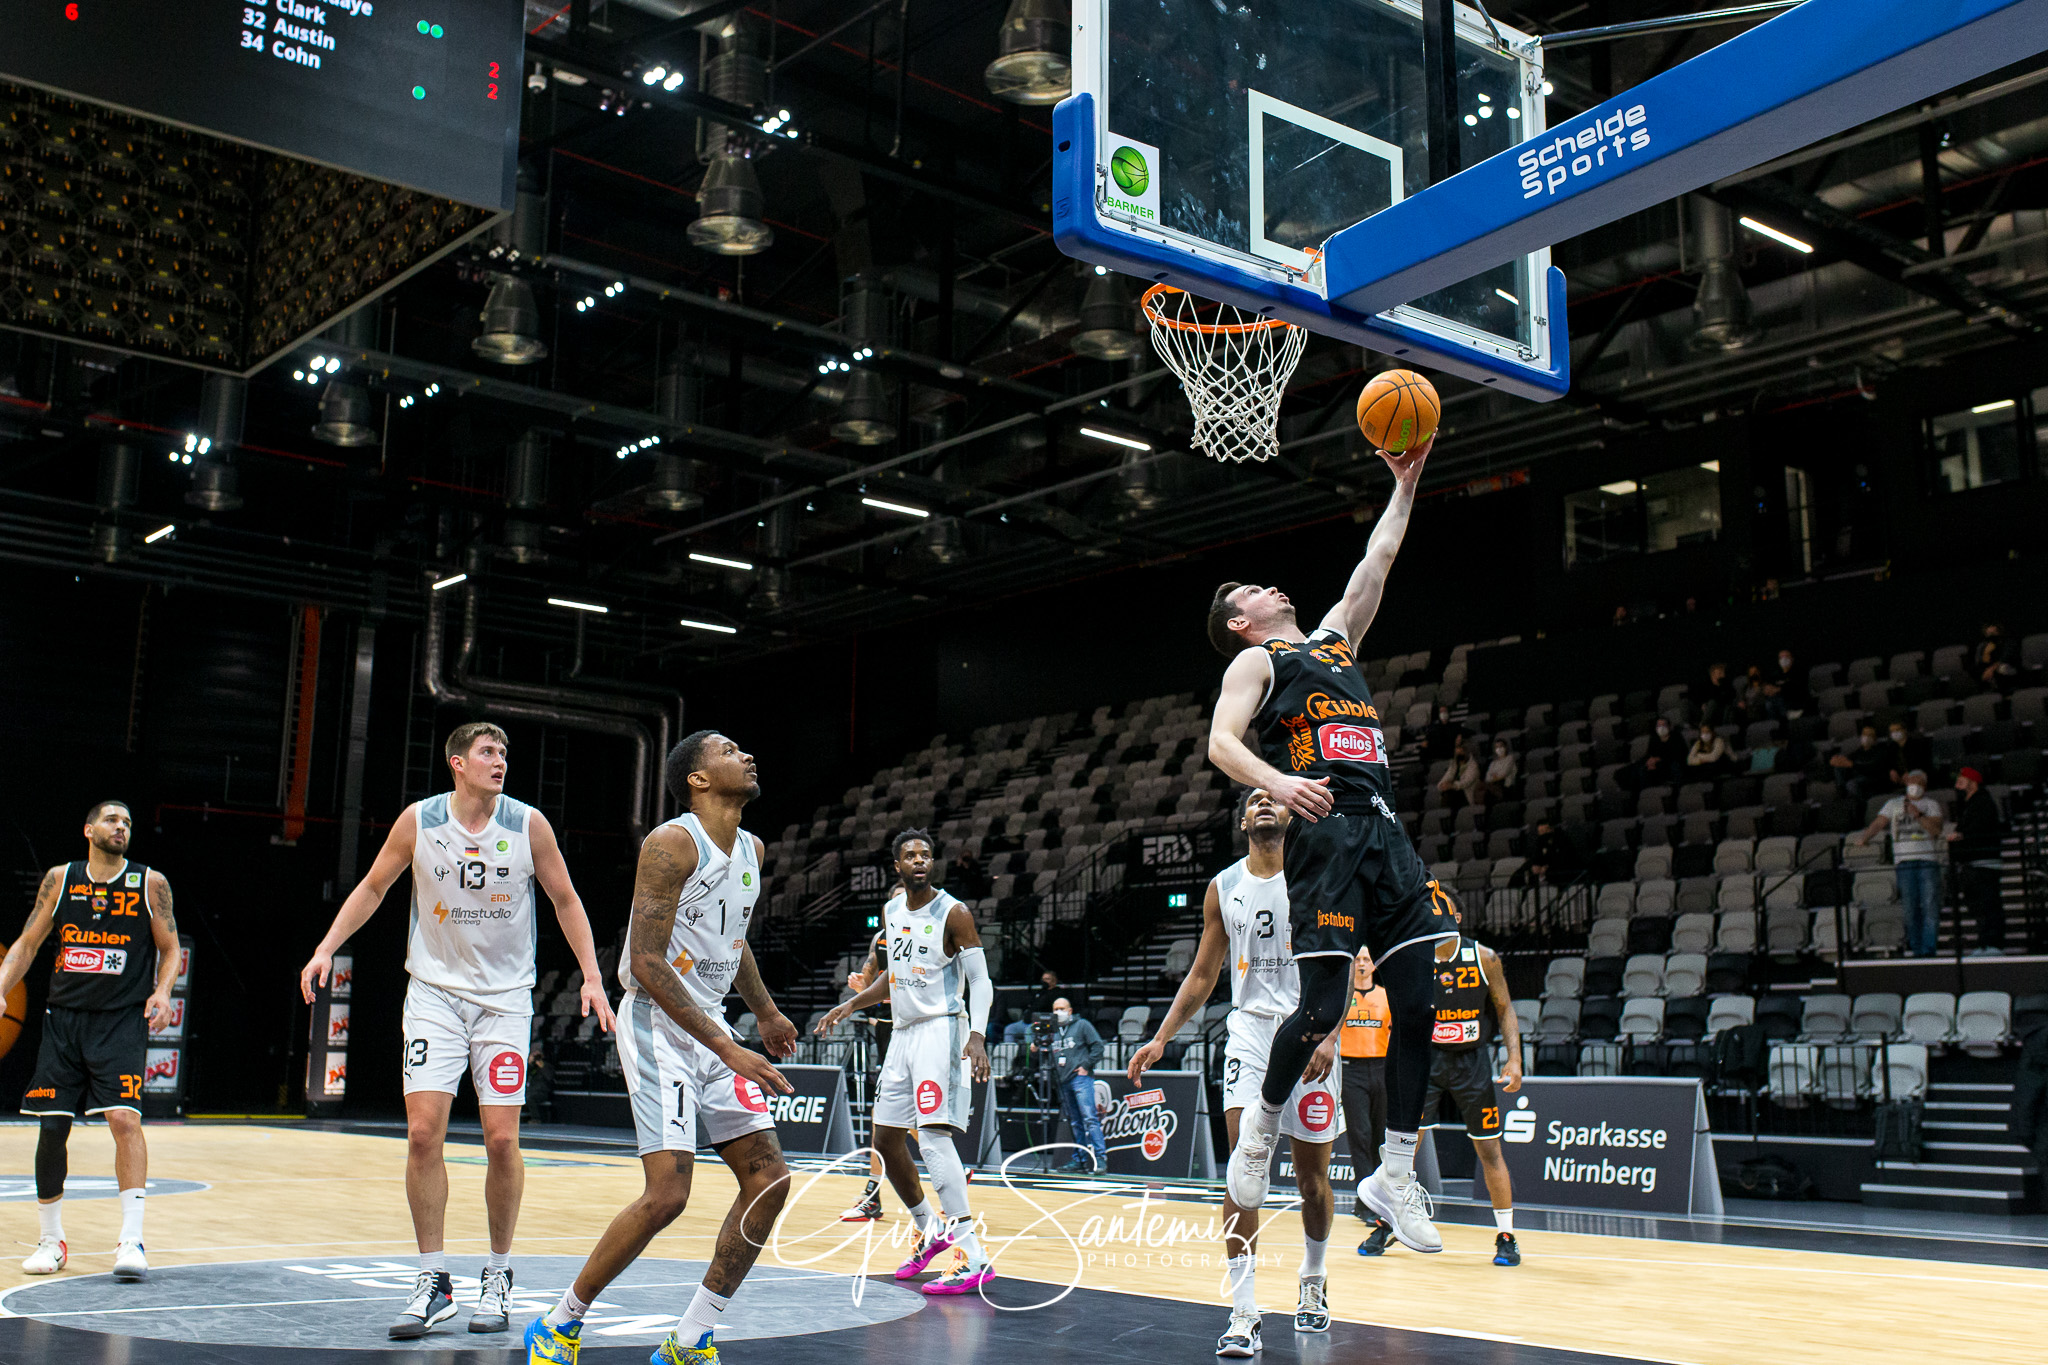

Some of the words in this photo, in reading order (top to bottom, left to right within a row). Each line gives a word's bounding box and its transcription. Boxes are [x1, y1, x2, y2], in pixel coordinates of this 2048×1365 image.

[65, 2, 79, 21] 6
[276, 0, 327, 26] Clark
[242, 7, 267, 30] 32
[273, 17, 336, 51] Austin
[240, 30, 265, 53] 34
[272, 40, 322, 70] Cohn
[488, 61, 500, 79] 2
[487, 83, 499, 100] 2
[1517, 104, 1647, 177] Schelde
[1521, 127, 1651, 200] Sports
[1107, 196, 1154, 220] BARMER
[1306, 692, 1380, 720] Küble
[1329, 733, 1373, 751] Helios
[457, 860, 487, 891] 13
[110, 891, 140, 917] 32
[451, 906, 512, 919] filmstudio
[718, 899, 726, 936] 1
[1256, 909, 1275, 939] 3
[62, 923, 131, 945] Kübler
[65, 953, 102, 966] Helios
[893, 937, 913, 962] 24
[1455, 966, 1480, 989] 23
[405, 1038, 428, 1069] 13
[119, 1074, 142, 1101] 32
[765, 1095, 827, 1124] ERGIE
[1481, 1106, 1500, 1130] 23
[1545, 1119, 1668, 1151] Sparkasse
[1543, 1156, 1657, 1193] Nürnberg
